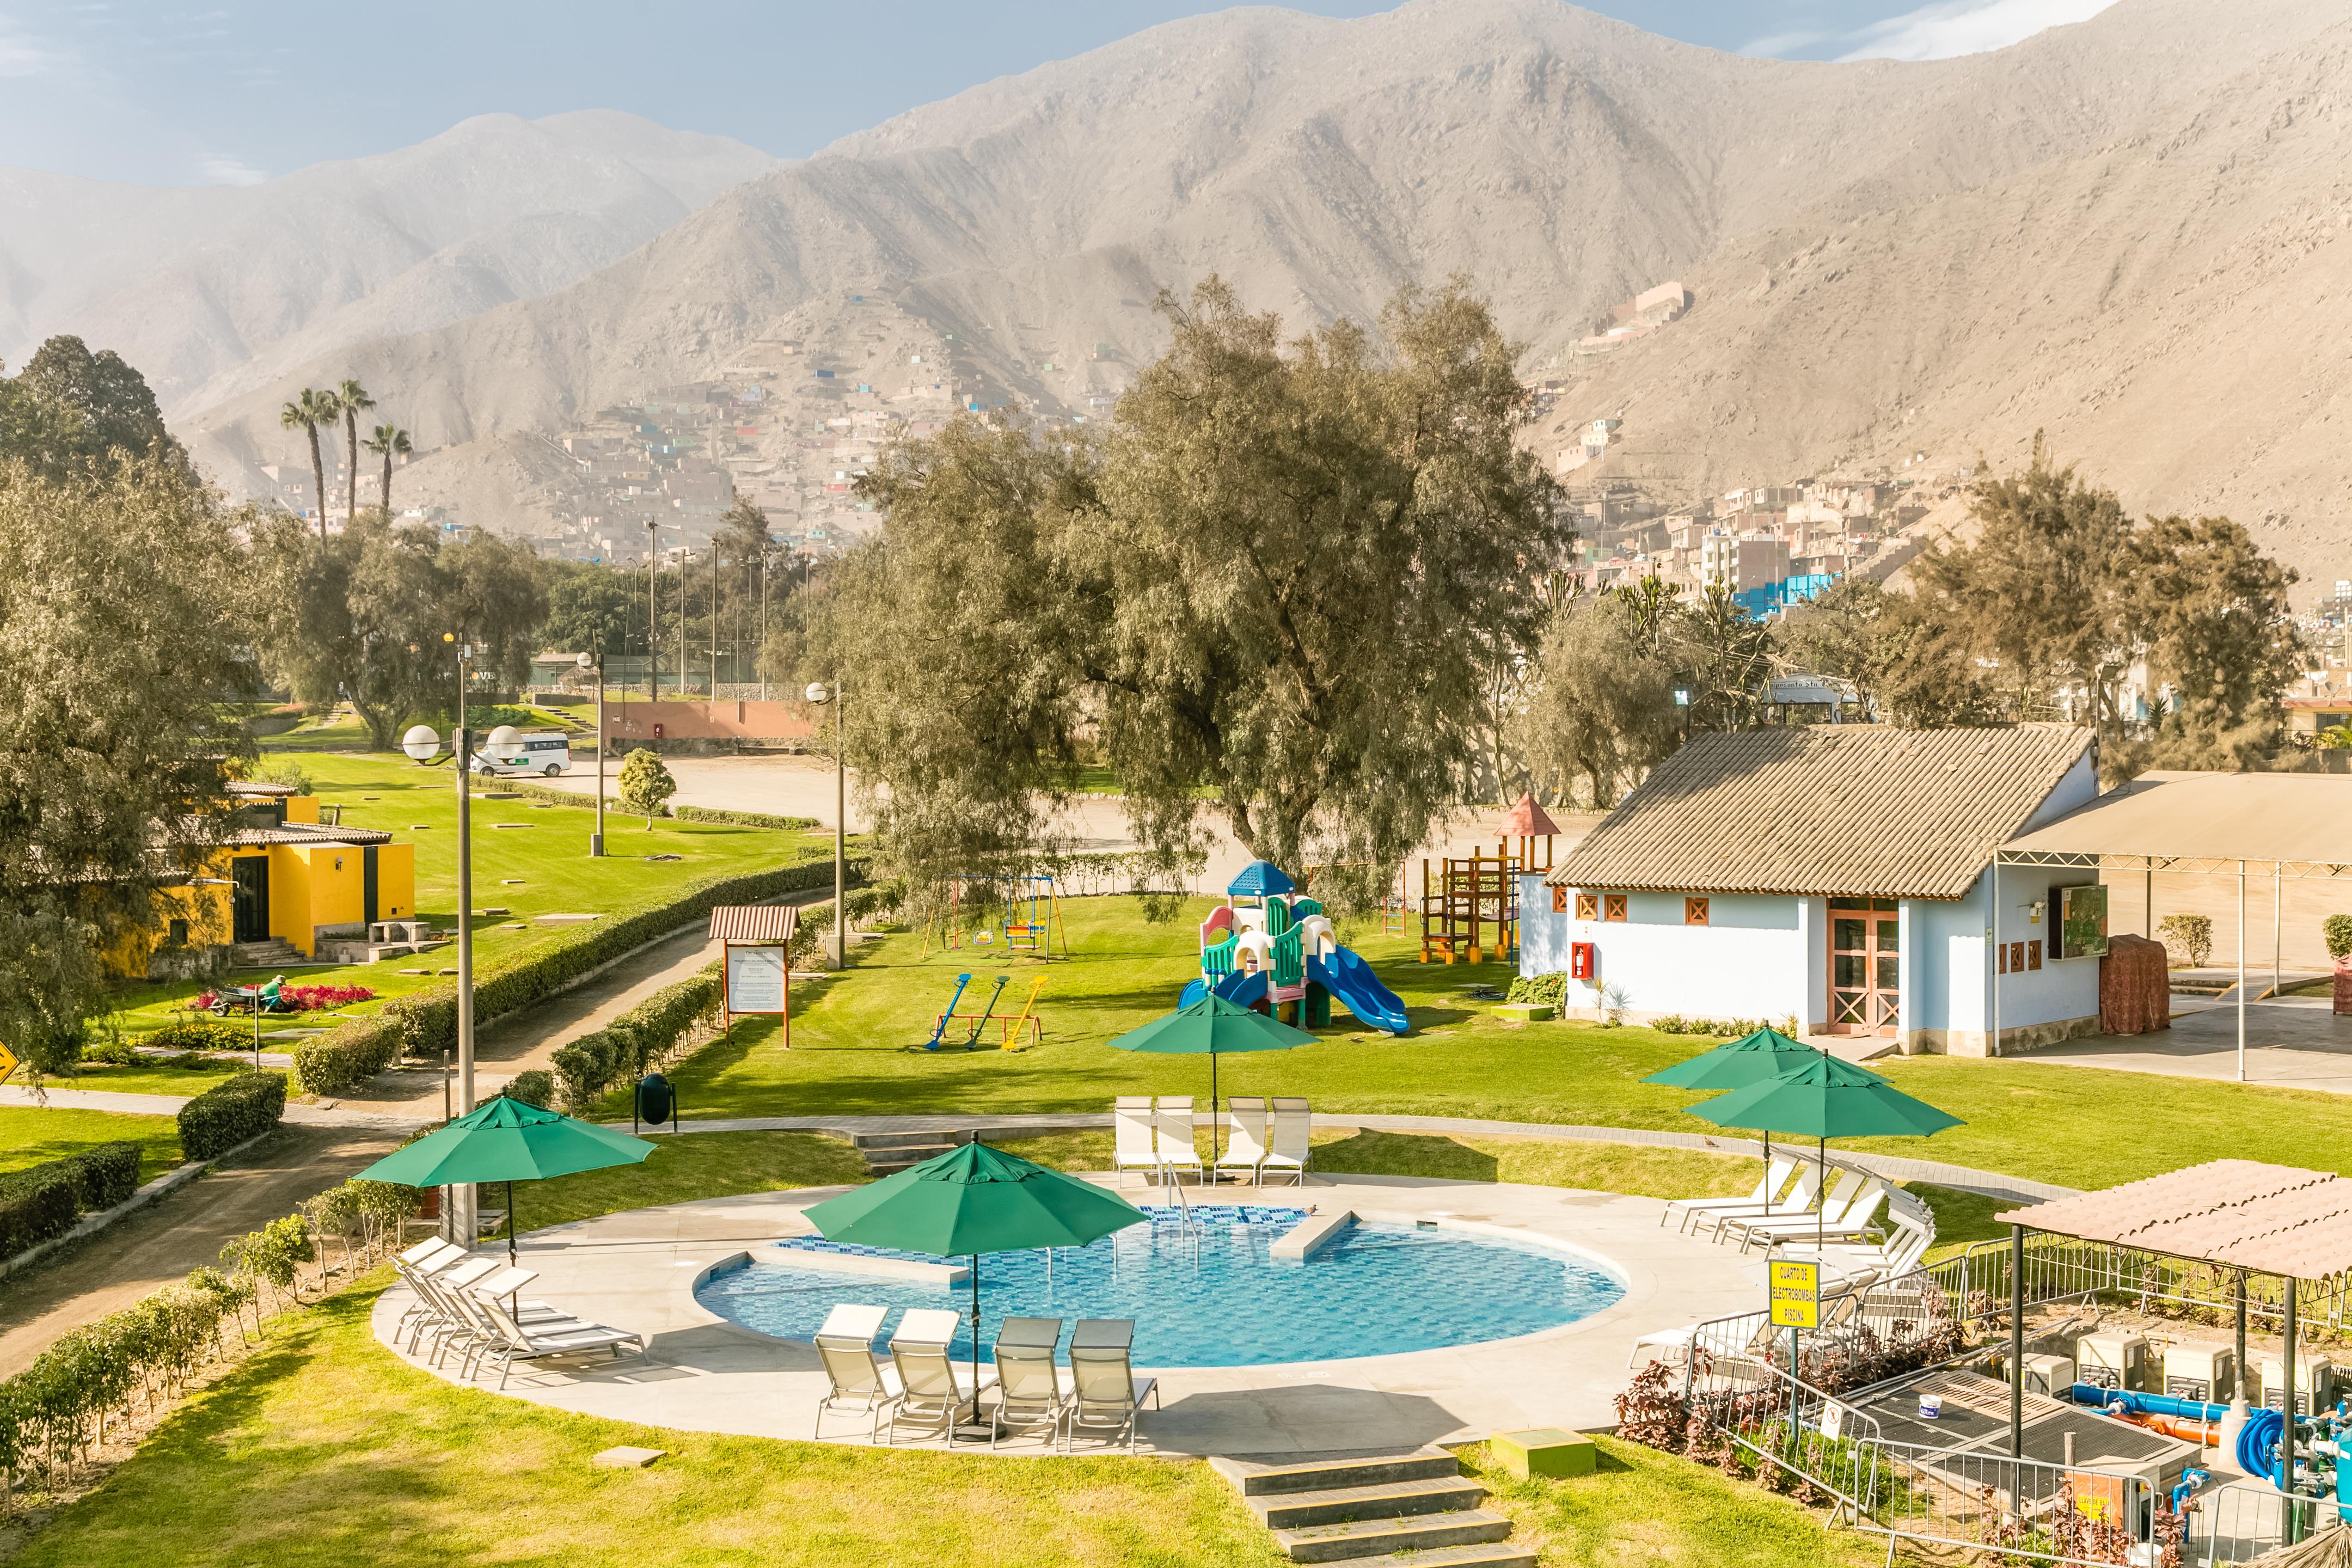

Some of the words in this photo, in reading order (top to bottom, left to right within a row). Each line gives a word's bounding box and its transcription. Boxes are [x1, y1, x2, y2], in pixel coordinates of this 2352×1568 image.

[1780, 1266, 1799, 1280] CUARTO
[1801, 1268, 1807, 1281] DE
[1773, 1287, 1815, 1302] ELECTROBOMBAS
[1785, 1308, 1804, 1322] PISCINA
